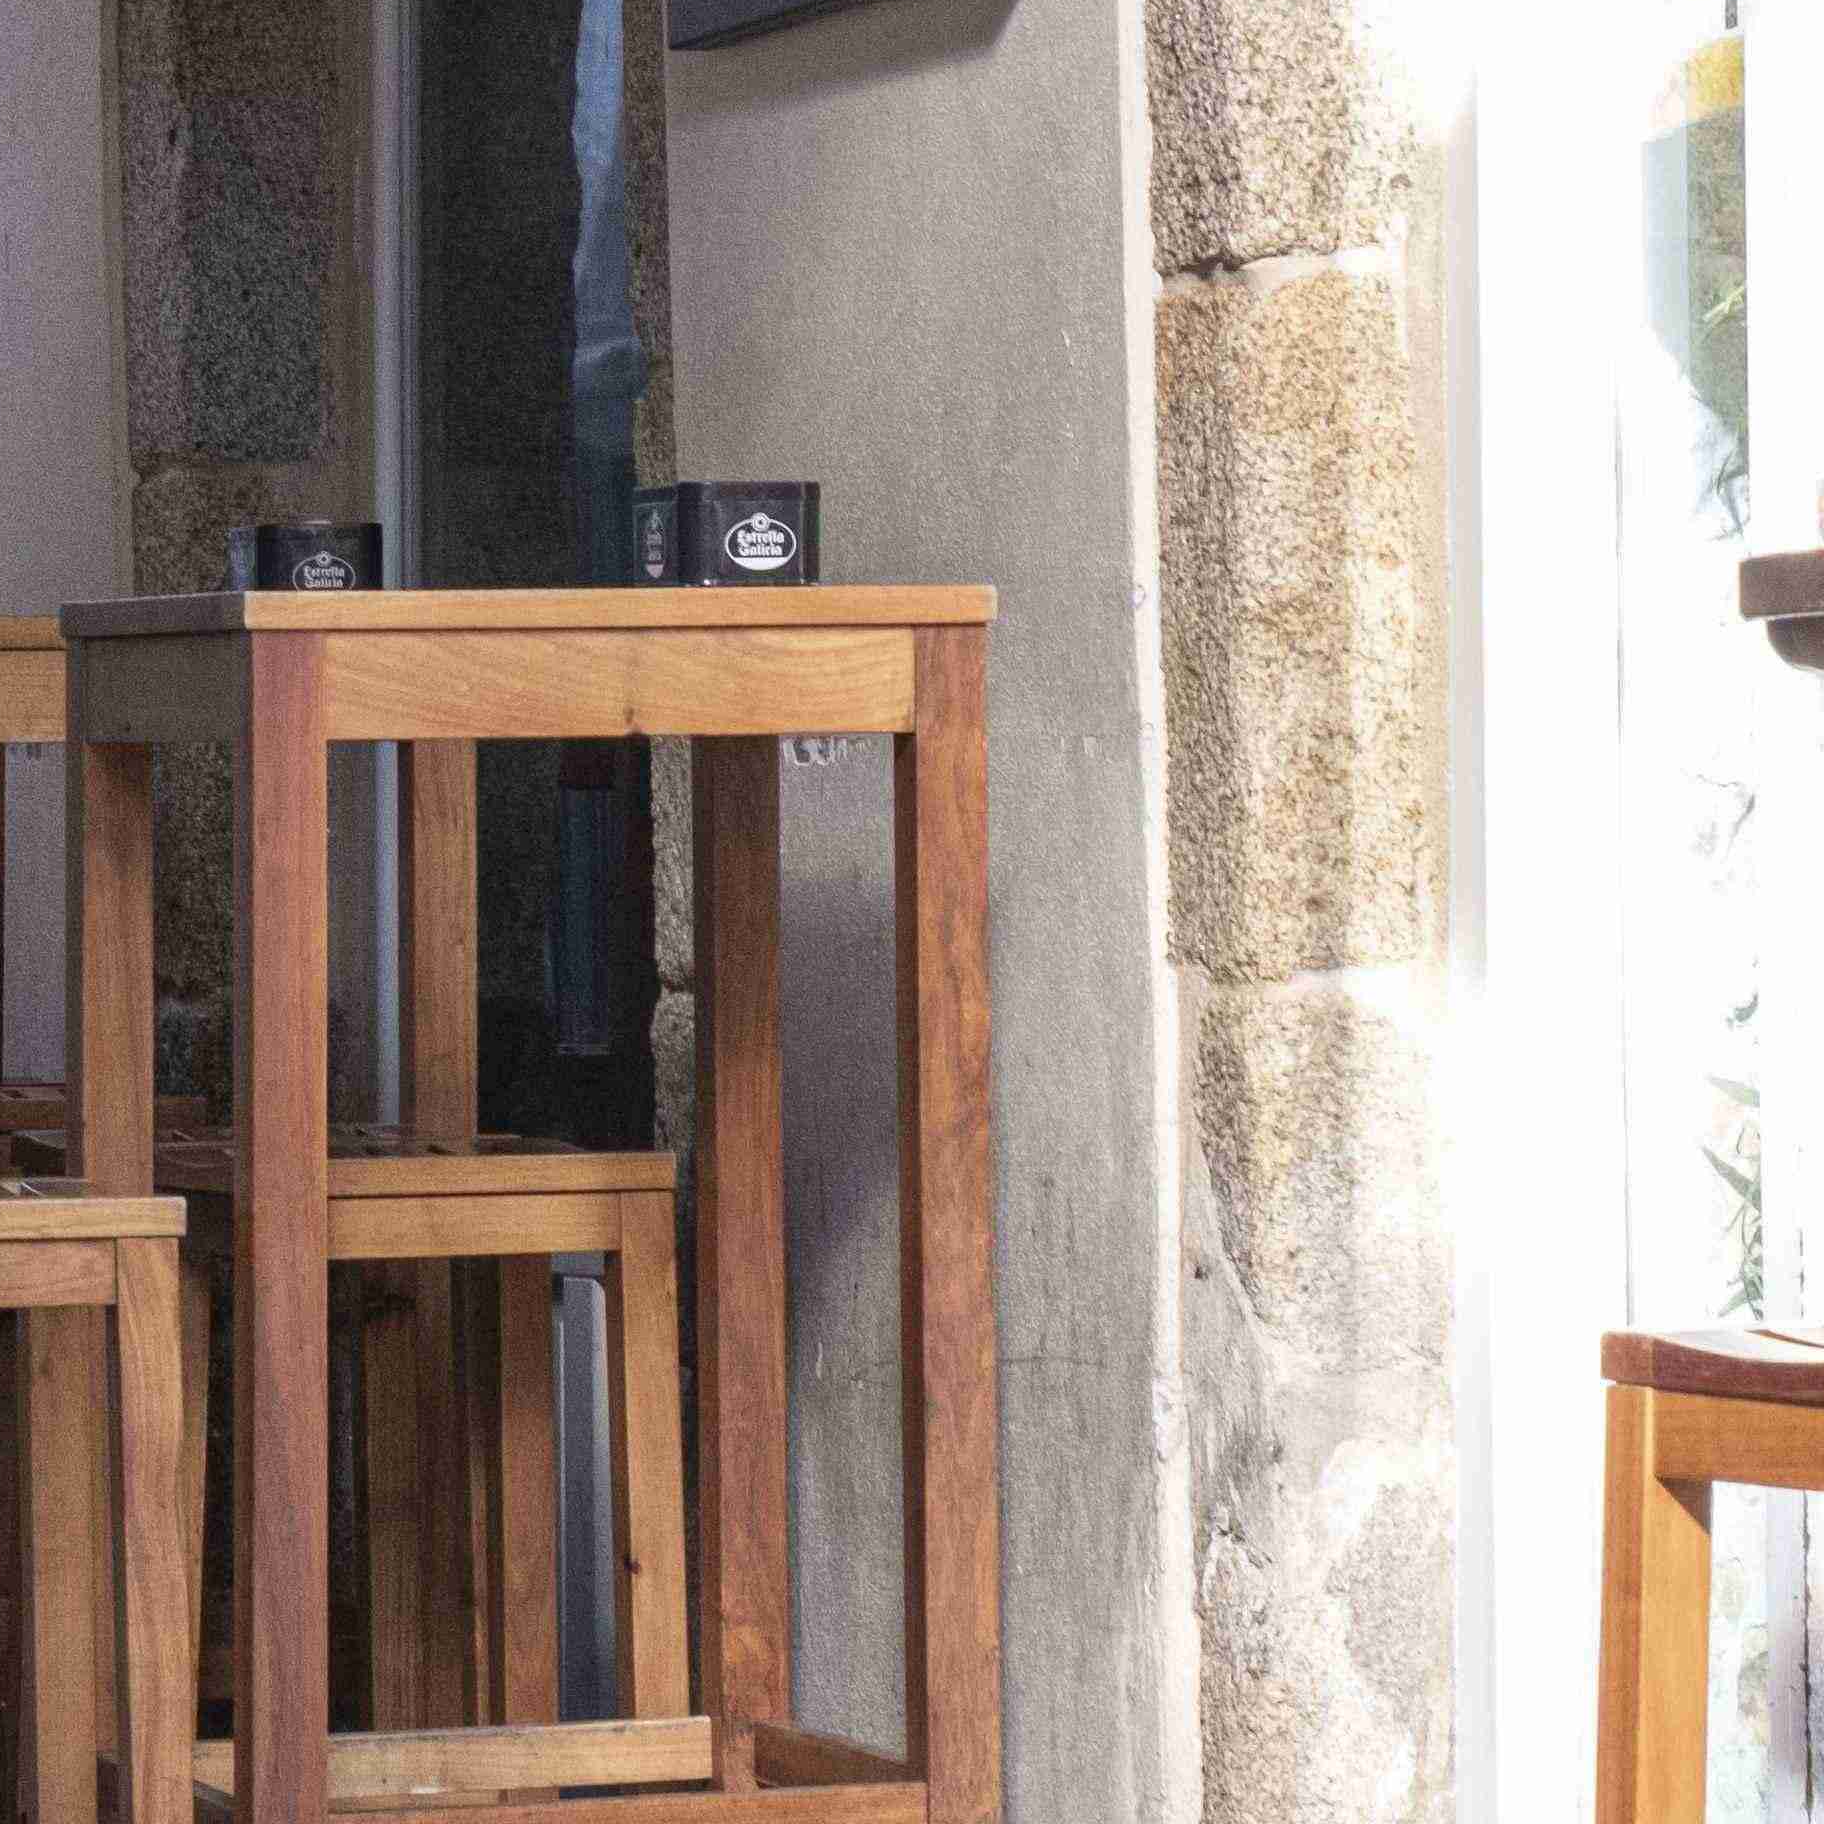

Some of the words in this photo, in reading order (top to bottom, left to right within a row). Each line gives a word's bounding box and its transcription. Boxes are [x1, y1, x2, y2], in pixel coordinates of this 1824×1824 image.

[737, 529, 785, 546] Estrella
[738, 543, 784, 557] Galicia
[304, 565, 345, 578] Estrella
